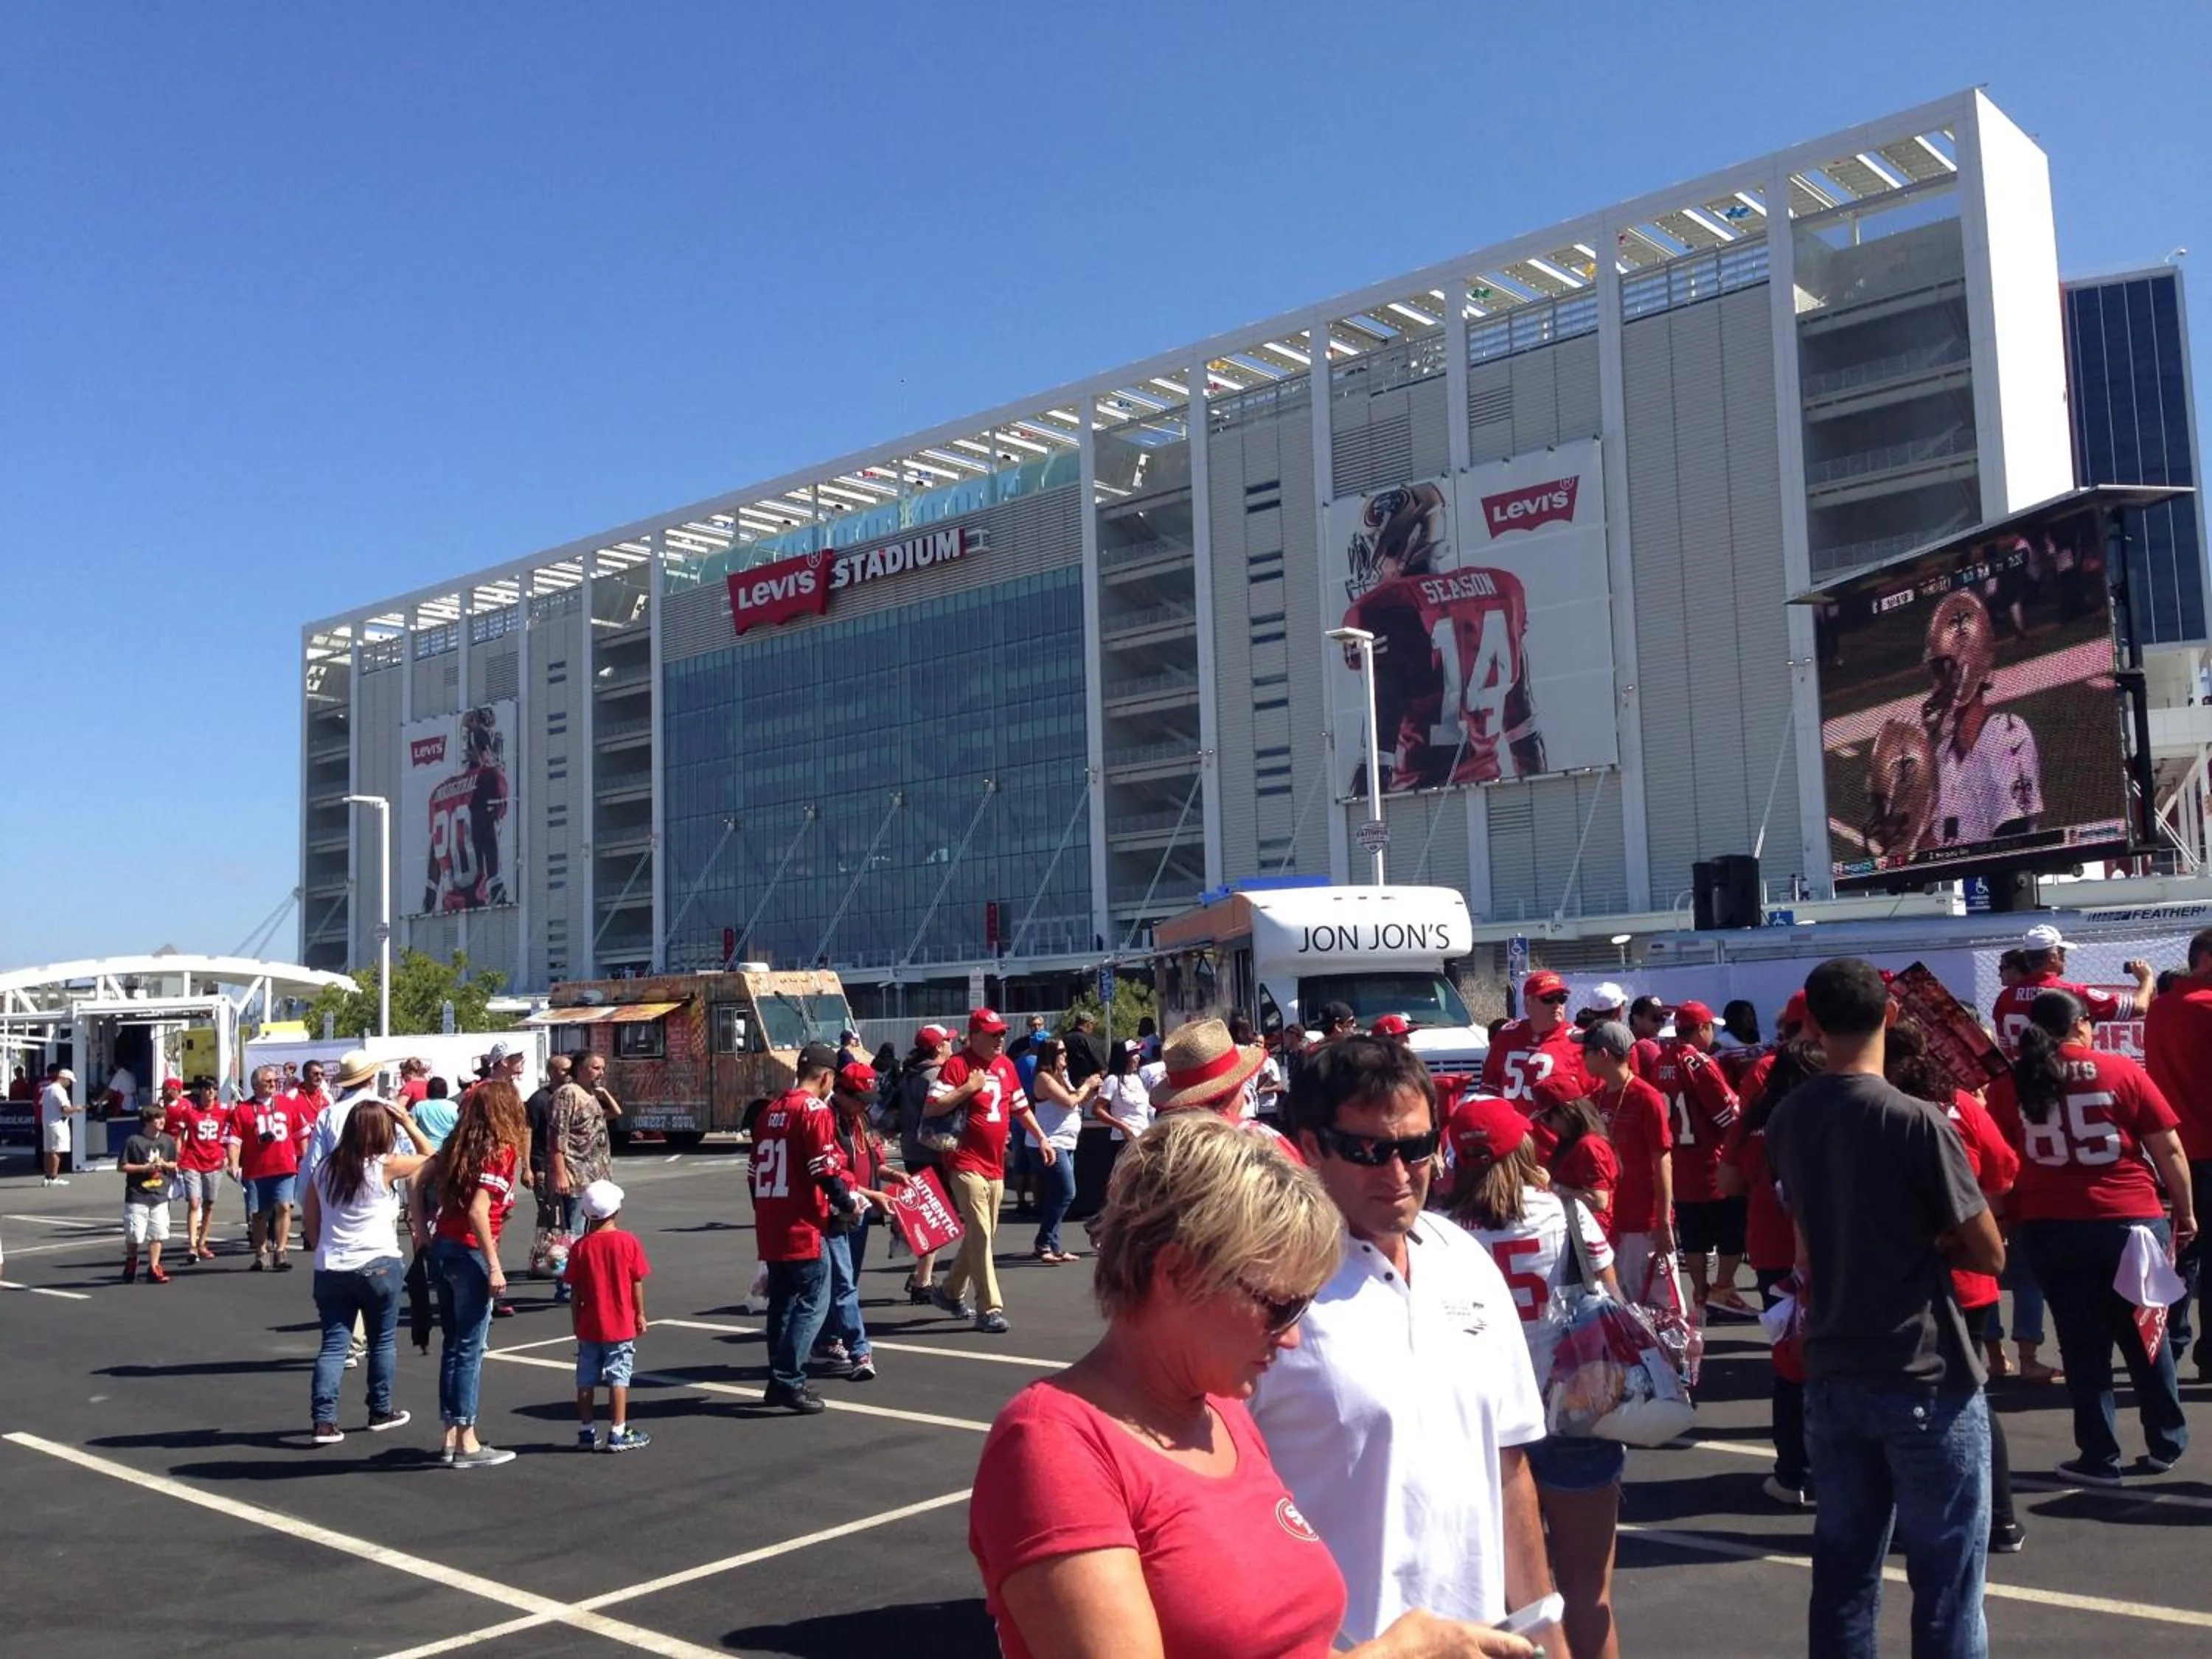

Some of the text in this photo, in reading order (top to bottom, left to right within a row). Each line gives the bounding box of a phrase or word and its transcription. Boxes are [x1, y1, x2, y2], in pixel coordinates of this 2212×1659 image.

[830, 528, 960, 589] STADIUM
[1422, 573, 1498, 605] SEASON
[1430, 610, 1515, 745] 14
[1298, 924, 1450, 953] JON JON'S
[982, 1076, 1002, 1122] 7
[198, 1119, 218, 1140] 52
[2019, 1092, 2121, 1166] 85
[755, 1138, 789, 1198] 21
[911, 1175, 959, 1237] AUTHENTIC
[919, 1203, 940, 1229] FAN
